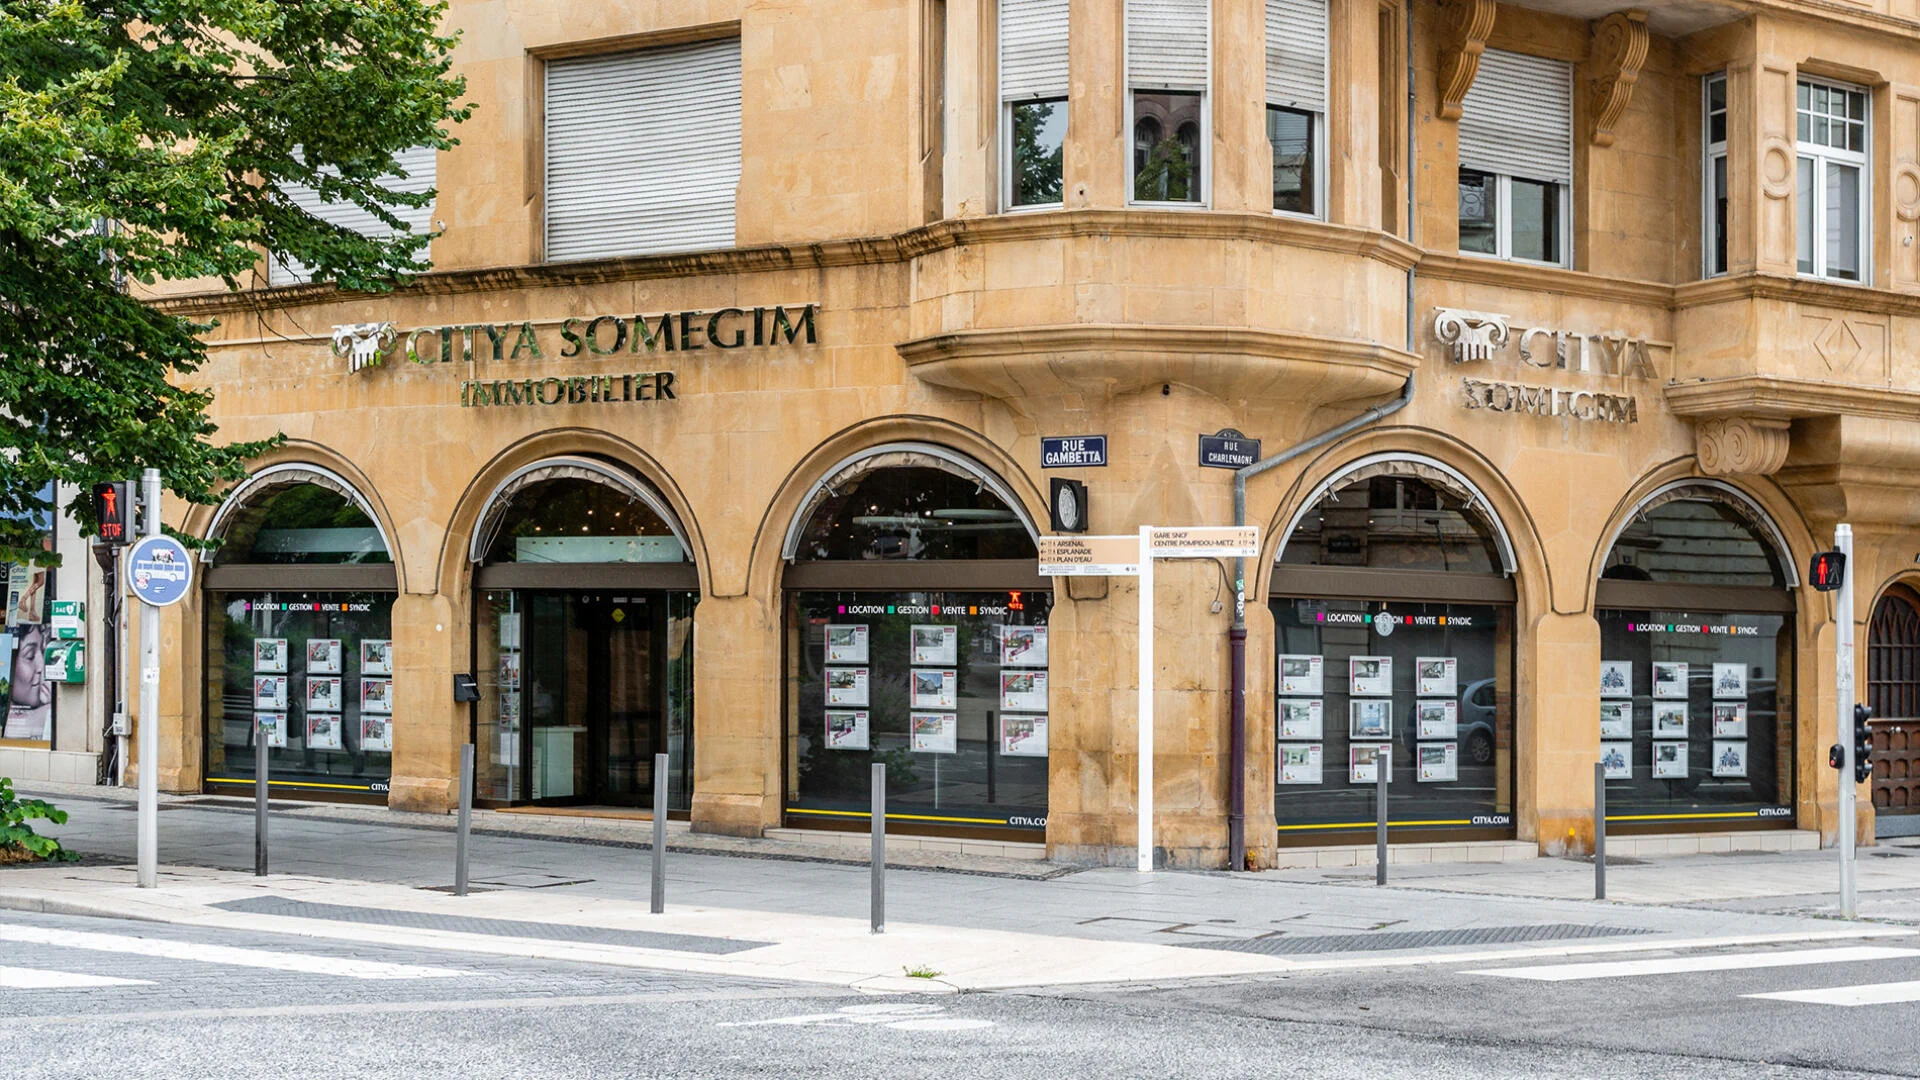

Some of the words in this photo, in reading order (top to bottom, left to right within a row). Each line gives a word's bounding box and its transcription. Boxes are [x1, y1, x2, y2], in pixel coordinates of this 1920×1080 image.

[406, 321, 544, 365] CITYA
[560, 303, 818, 358] SOMEGIM
[1519, 327, 1658, 379] CITYA
[461, 370, 679, 408] IMMOBILIER
[1464, 377, 1639, 424] SOMEGIM
[1062, 440, 1086, 451] RUE
[1223, 441, 1239, 451] RUE
[1045, 450, 1102, 464] GAMBETTA
[1208, 452, 1254, 465] CHARLEMAGNE
[101, 523, 122, 537] STOP
[252, 603, 280, 611] LOCATION
[288, 603, 313, 611] GESTION
[321, 603, 340, 611] VENTE
[349, 604, 370, 612] SYNDIC
[848, 605, 885, 614] LOCATION
[897, 606, 929, 615] GESTION
[942, 606, 966, 615] VENTE
[979, 607, 1008, 616] SYNDIC
[1327, 614, 1362, 623] LOCATION
[1415, 616, 1436, 625] VENTE
[1447, 616, 1472, 626] SYNDIC
[1636, 623, 1666, 632] LOCATION
[1675, 625, 1701, 633] GESTION
[1709, 625, 1728, 634] VENTE
[1737, 626, 1758, 635] SYNDIC
[1009, 816, 1047, 826] CITYA.CO
[1472, 815, 1510, 824] CITYA.COM
